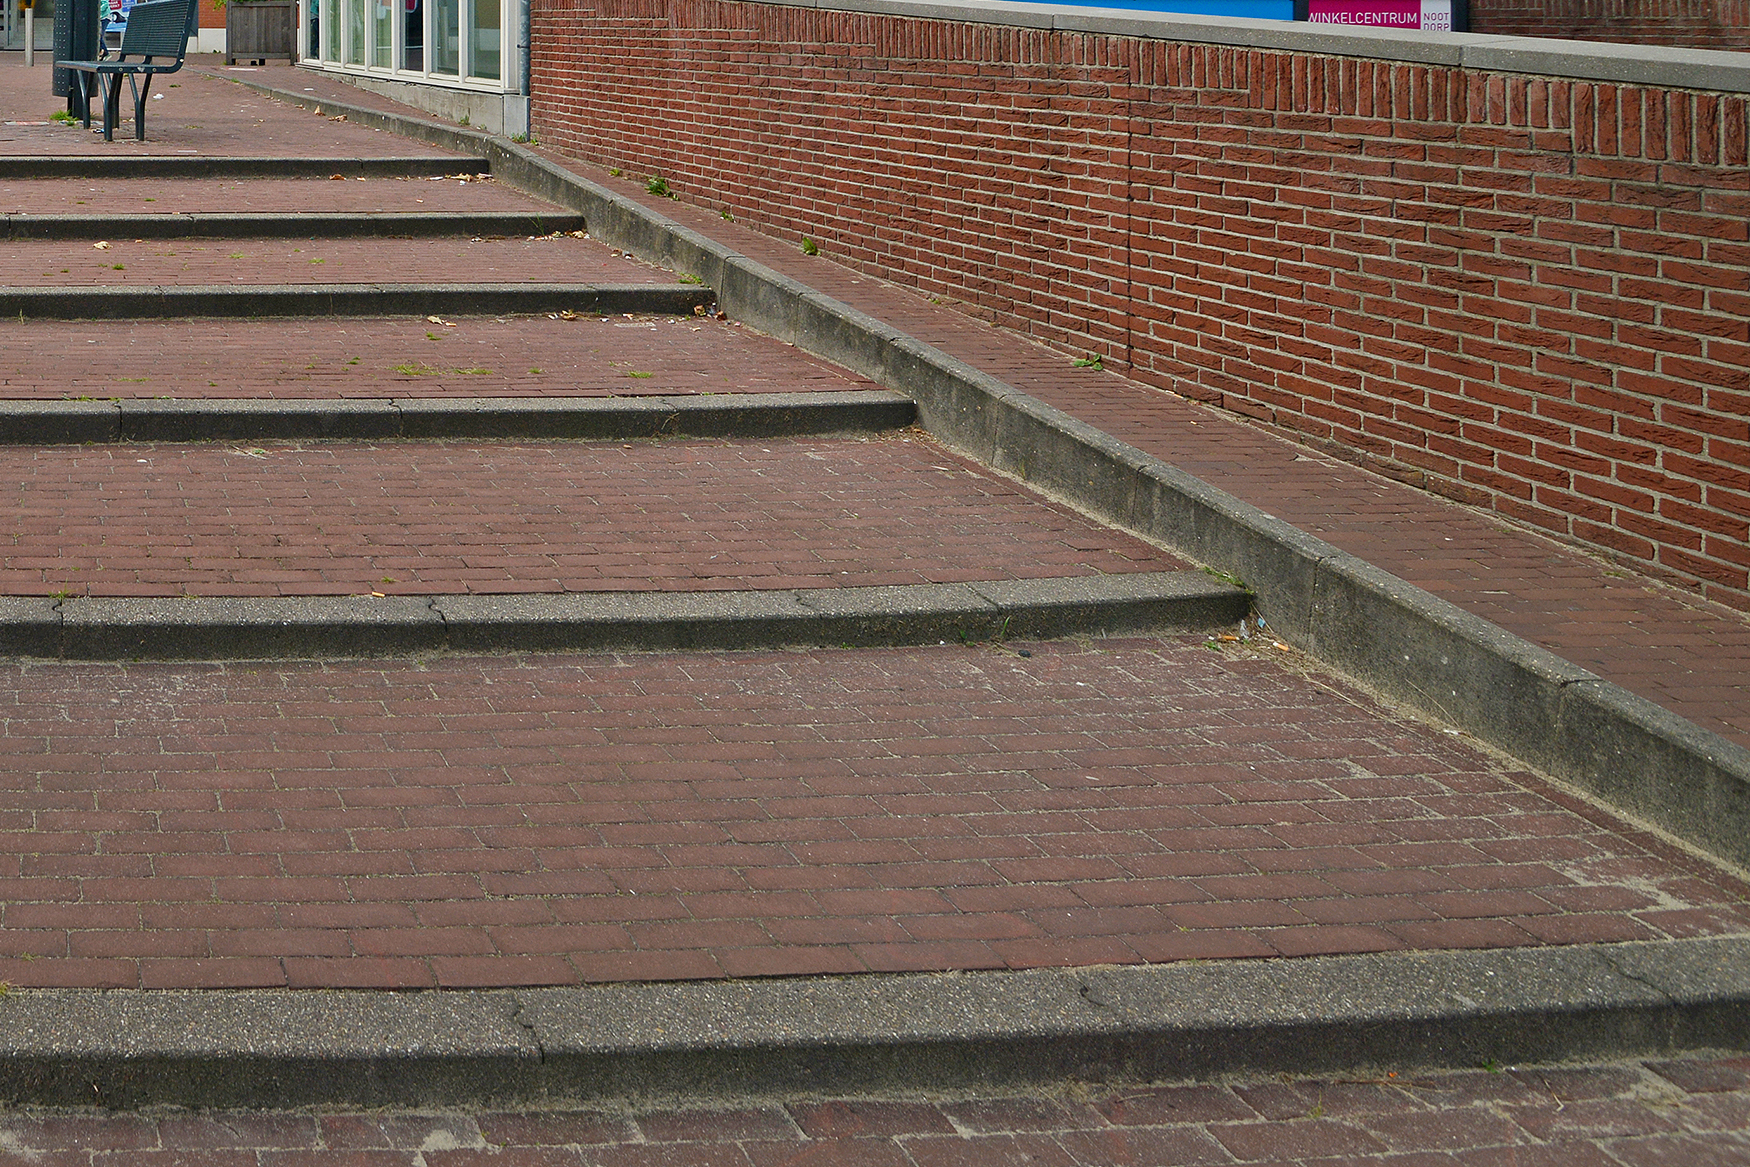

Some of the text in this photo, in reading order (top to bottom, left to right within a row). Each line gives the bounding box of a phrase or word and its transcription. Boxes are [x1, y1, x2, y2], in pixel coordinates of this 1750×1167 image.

[1308, 12, 1418, 24] WINKELCENTRUM
[1423, 13, 1450, 21] NOOT
[1423, 23, 1450, 32] DORP
